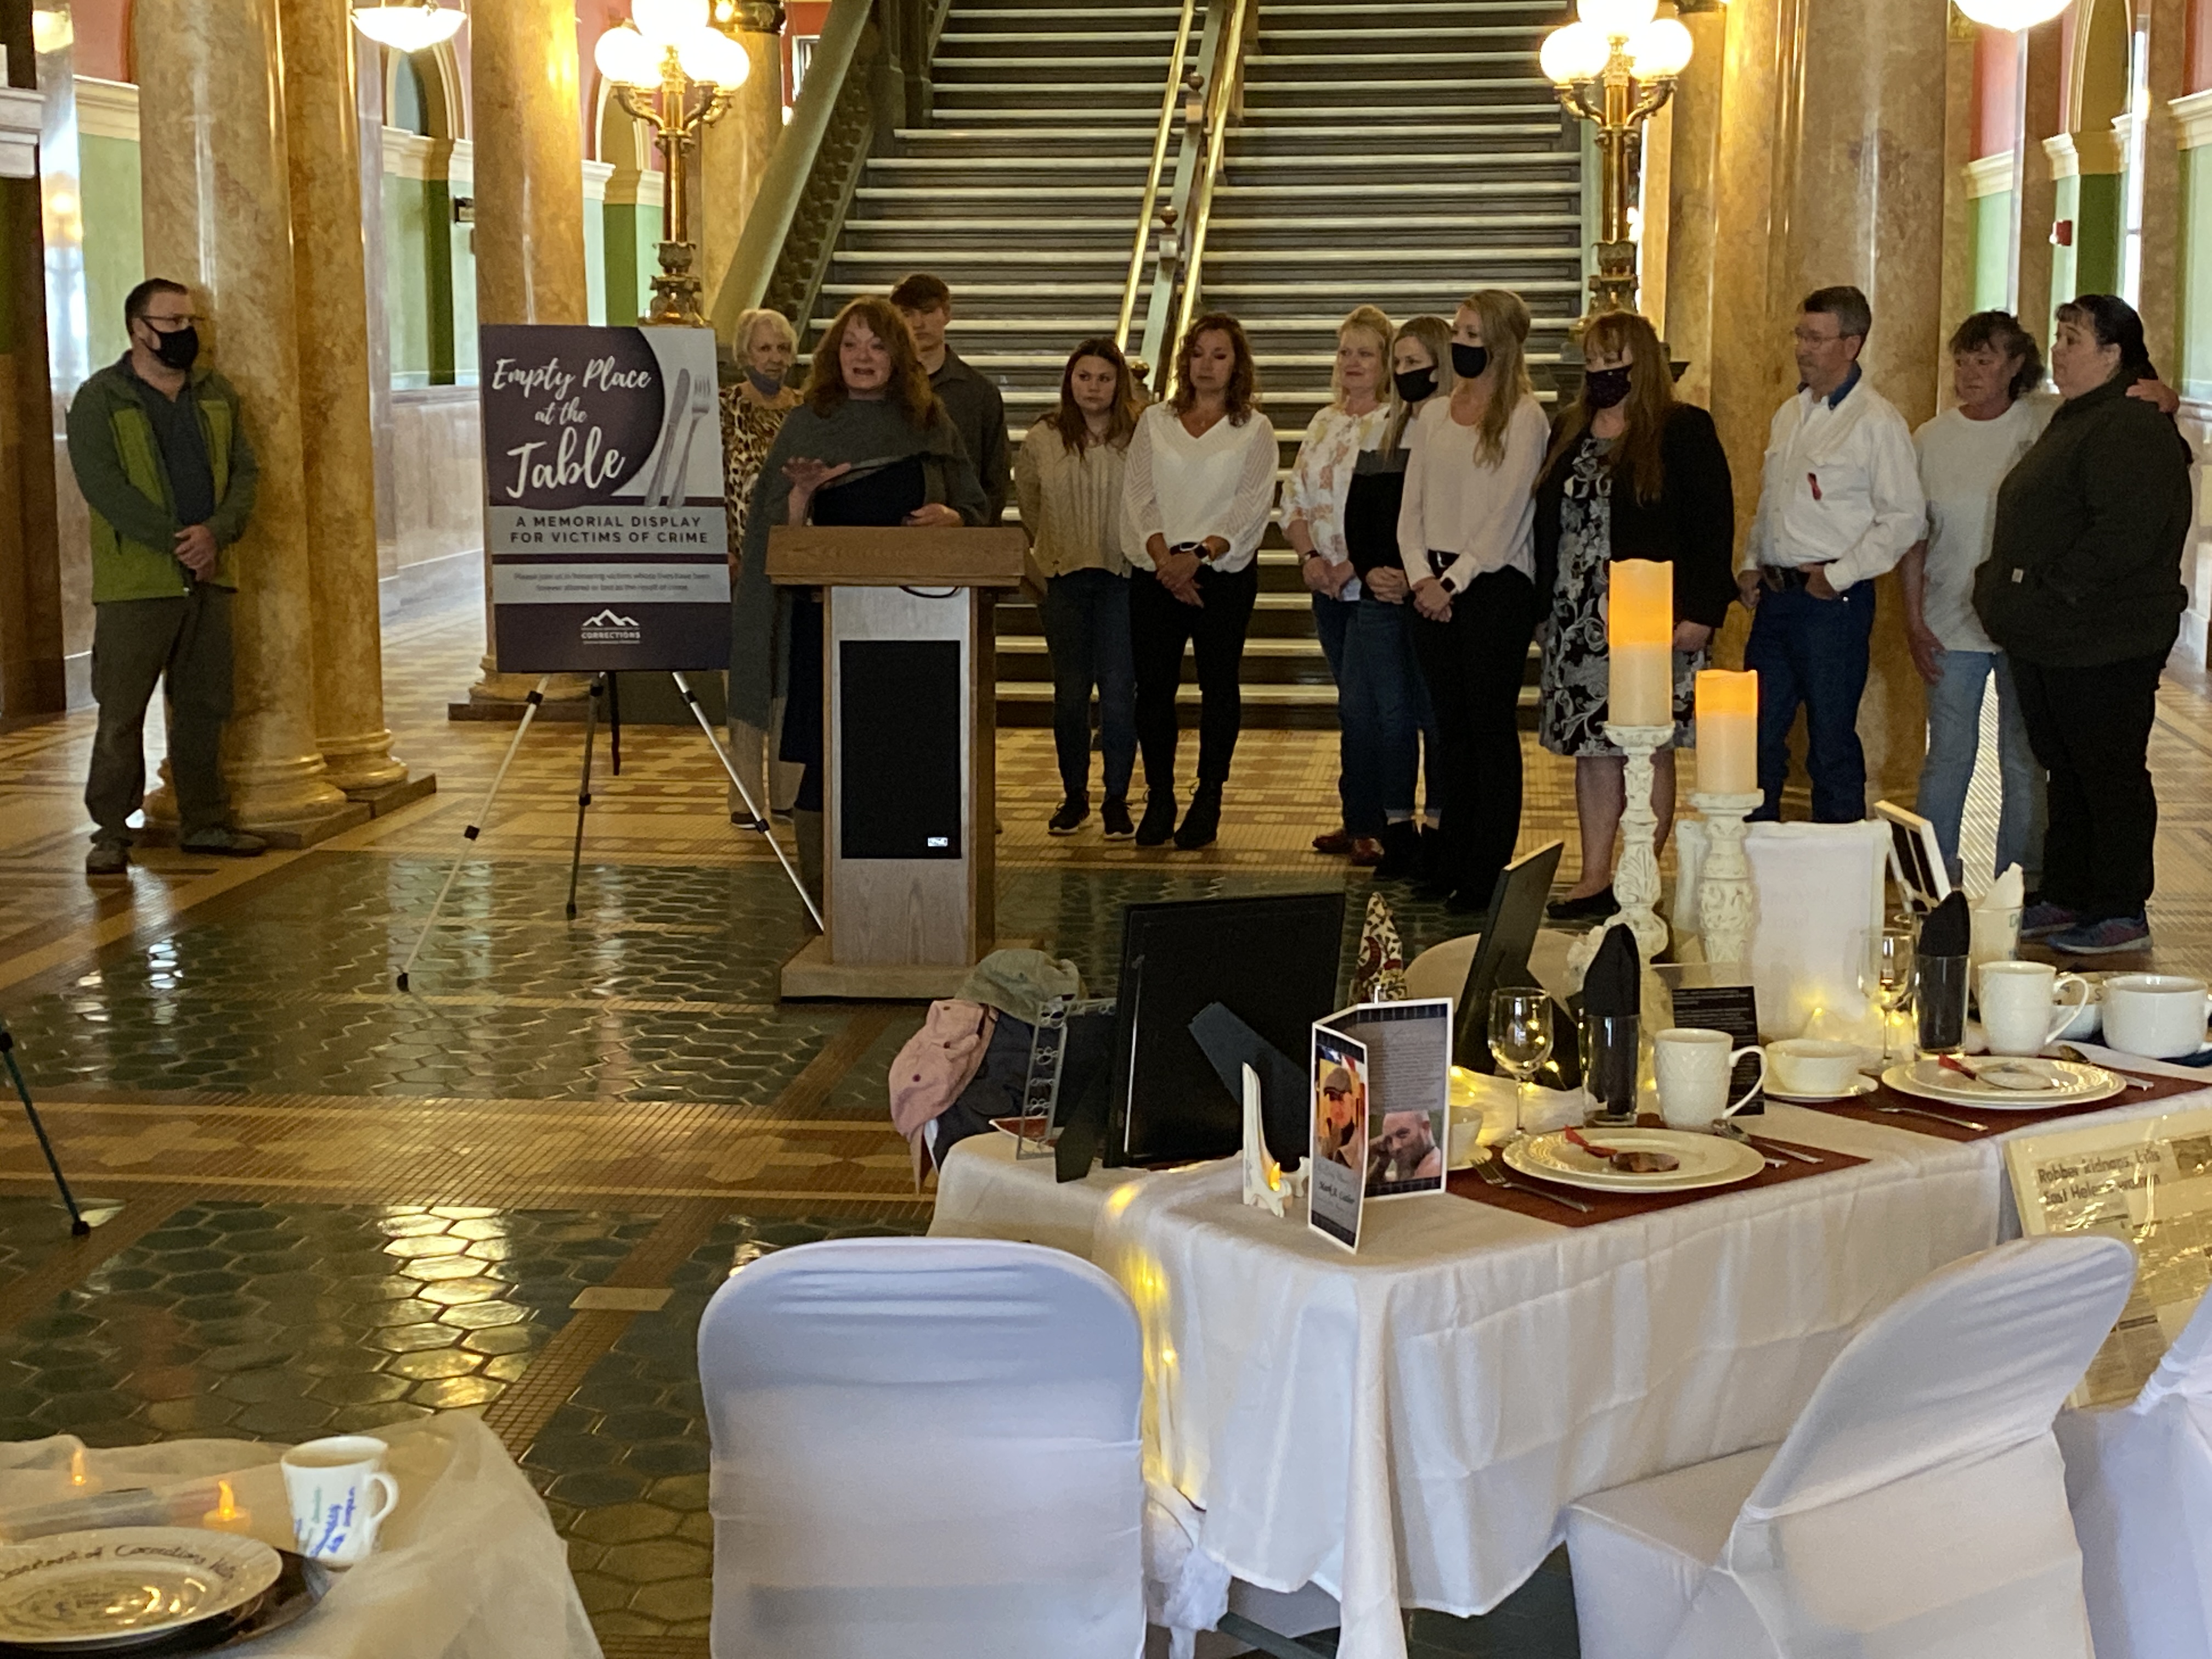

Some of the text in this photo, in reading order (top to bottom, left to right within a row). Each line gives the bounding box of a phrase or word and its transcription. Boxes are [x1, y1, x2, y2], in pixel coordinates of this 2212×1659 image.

[492, 356, 652, 400] Empty Place
[534, 396, 588, 425] at the
[506, 426, 626, 498] Table
[515, 516, 702, 528] A MEMORIAL DISPLAY
[510, 532, 708, 543] FOR VICTIMS OF CRIME
[2038, 1163, 2079, 1183] Robber
